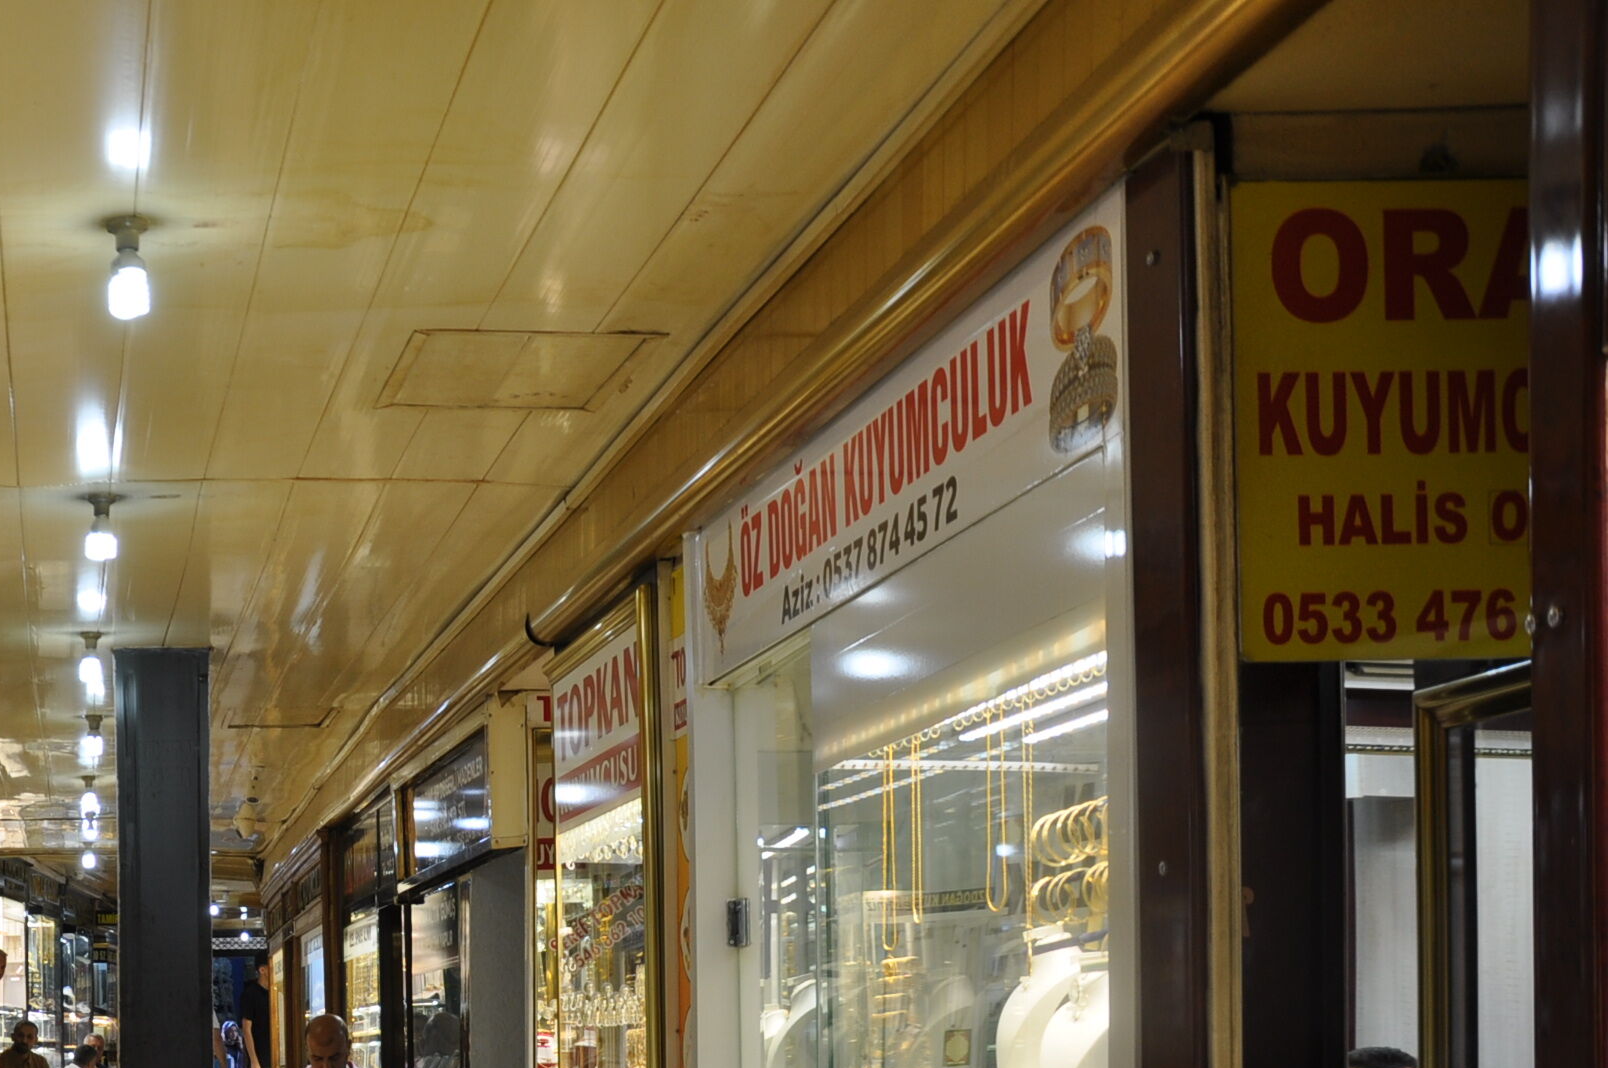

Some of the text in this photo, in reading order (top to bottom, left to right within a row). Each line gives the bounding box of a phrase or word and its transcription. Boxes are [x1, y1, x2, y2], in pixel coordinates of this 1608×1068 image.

[740, 298, 1033, 598] ÖZ DOĞAN KUYUMCULUK
[867, 512, 901, 571] 874
[904, 494, 928, 547] 45
[933, 475, 958, 532] 72
[1297, 479, 1469, 547] HALİS
[1262, 588, 1518, 646] 0533 476
[556, 640, 640, 762] TOPKAN
